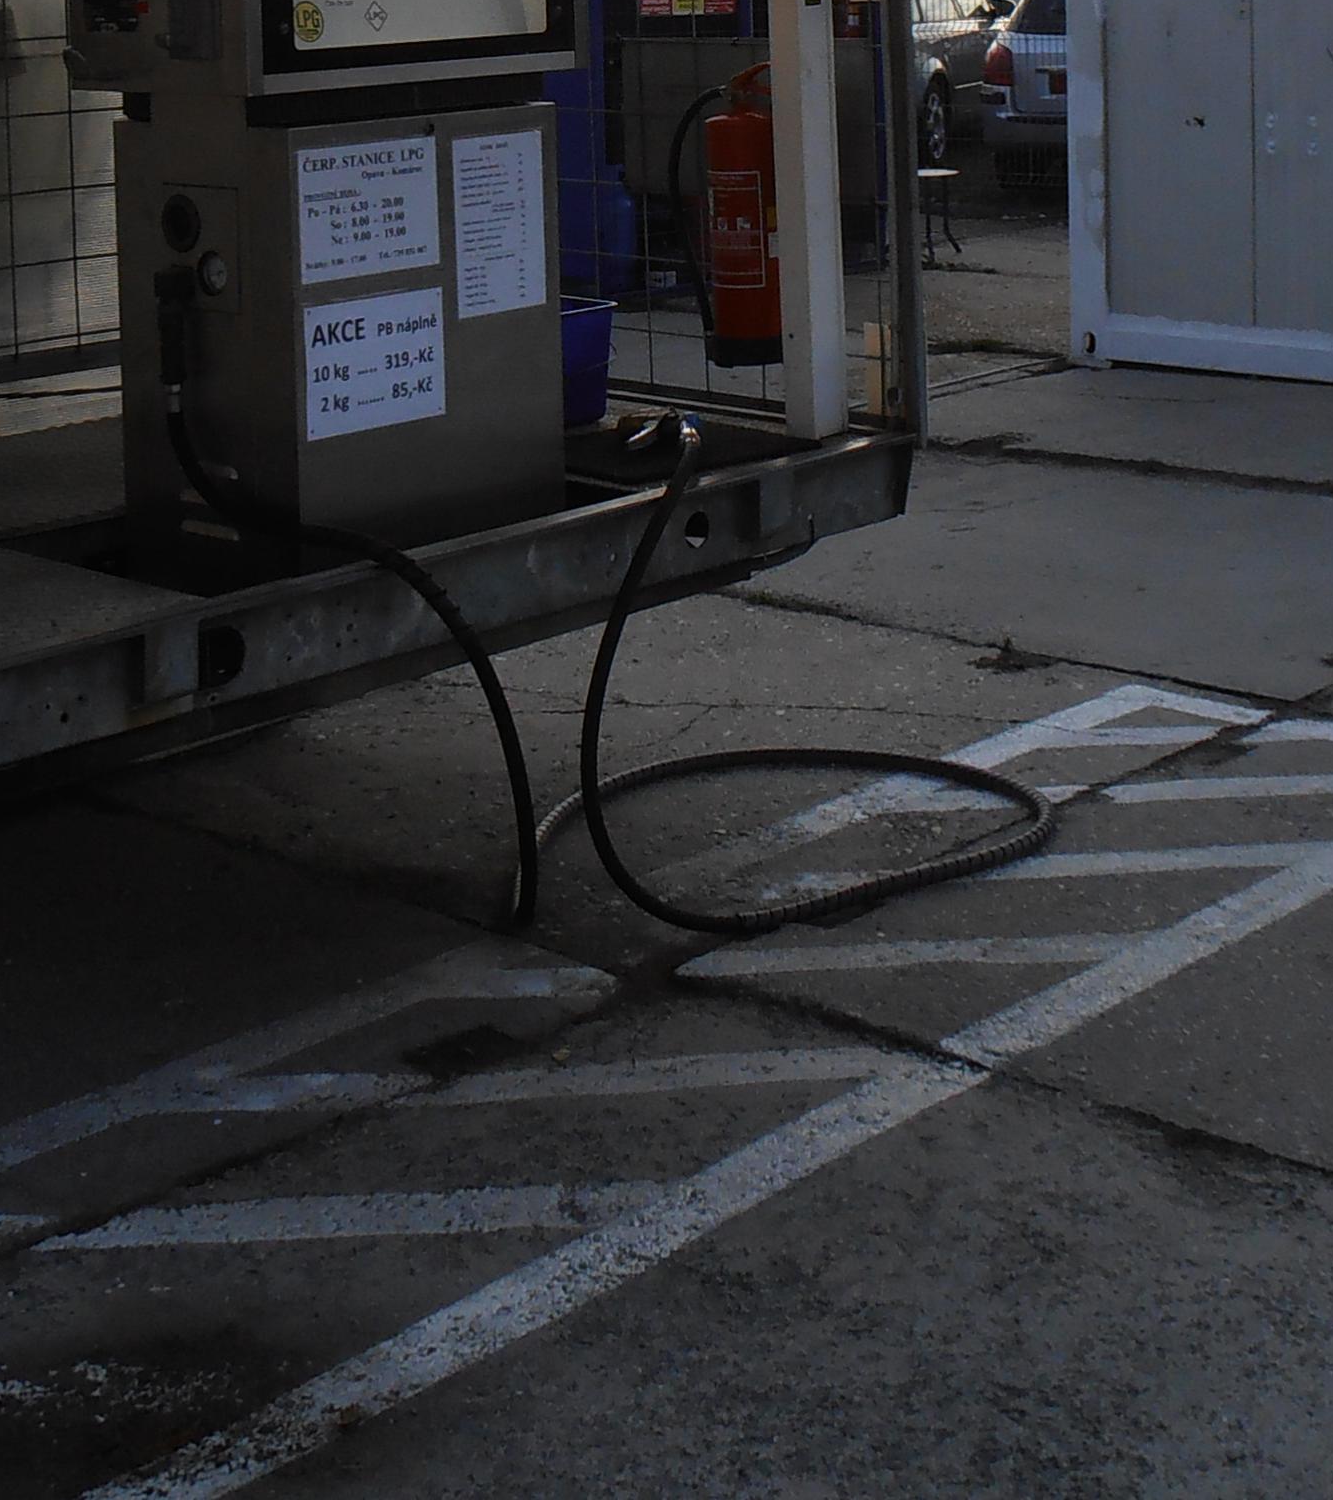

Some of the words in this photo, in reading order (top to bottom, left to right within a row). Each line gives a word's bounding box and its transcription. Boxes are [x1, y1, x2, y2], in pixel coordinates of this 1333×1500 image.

[296, 10, 320, 29] LPG
[302, 156, 340, 173] ČERP.
[341, 150, 395, 169] STANICE
[400, 147, 425, 161] LPG
[307, 207, 320, 218] Po
[310, 317, 366, 349] AKCE
[377, 321, 394, 337] PB
[396, 313, 438, 334] náplně
[312, 365, 331, 383] 10
[333, 363, 350, 382] kg
[384, 345, 435, 371] 319,-Kč
[320, 397, 330, 413] 2
[333, 393, 350, 413] kg
[391, 375, 434, 400] 85,-Kč
